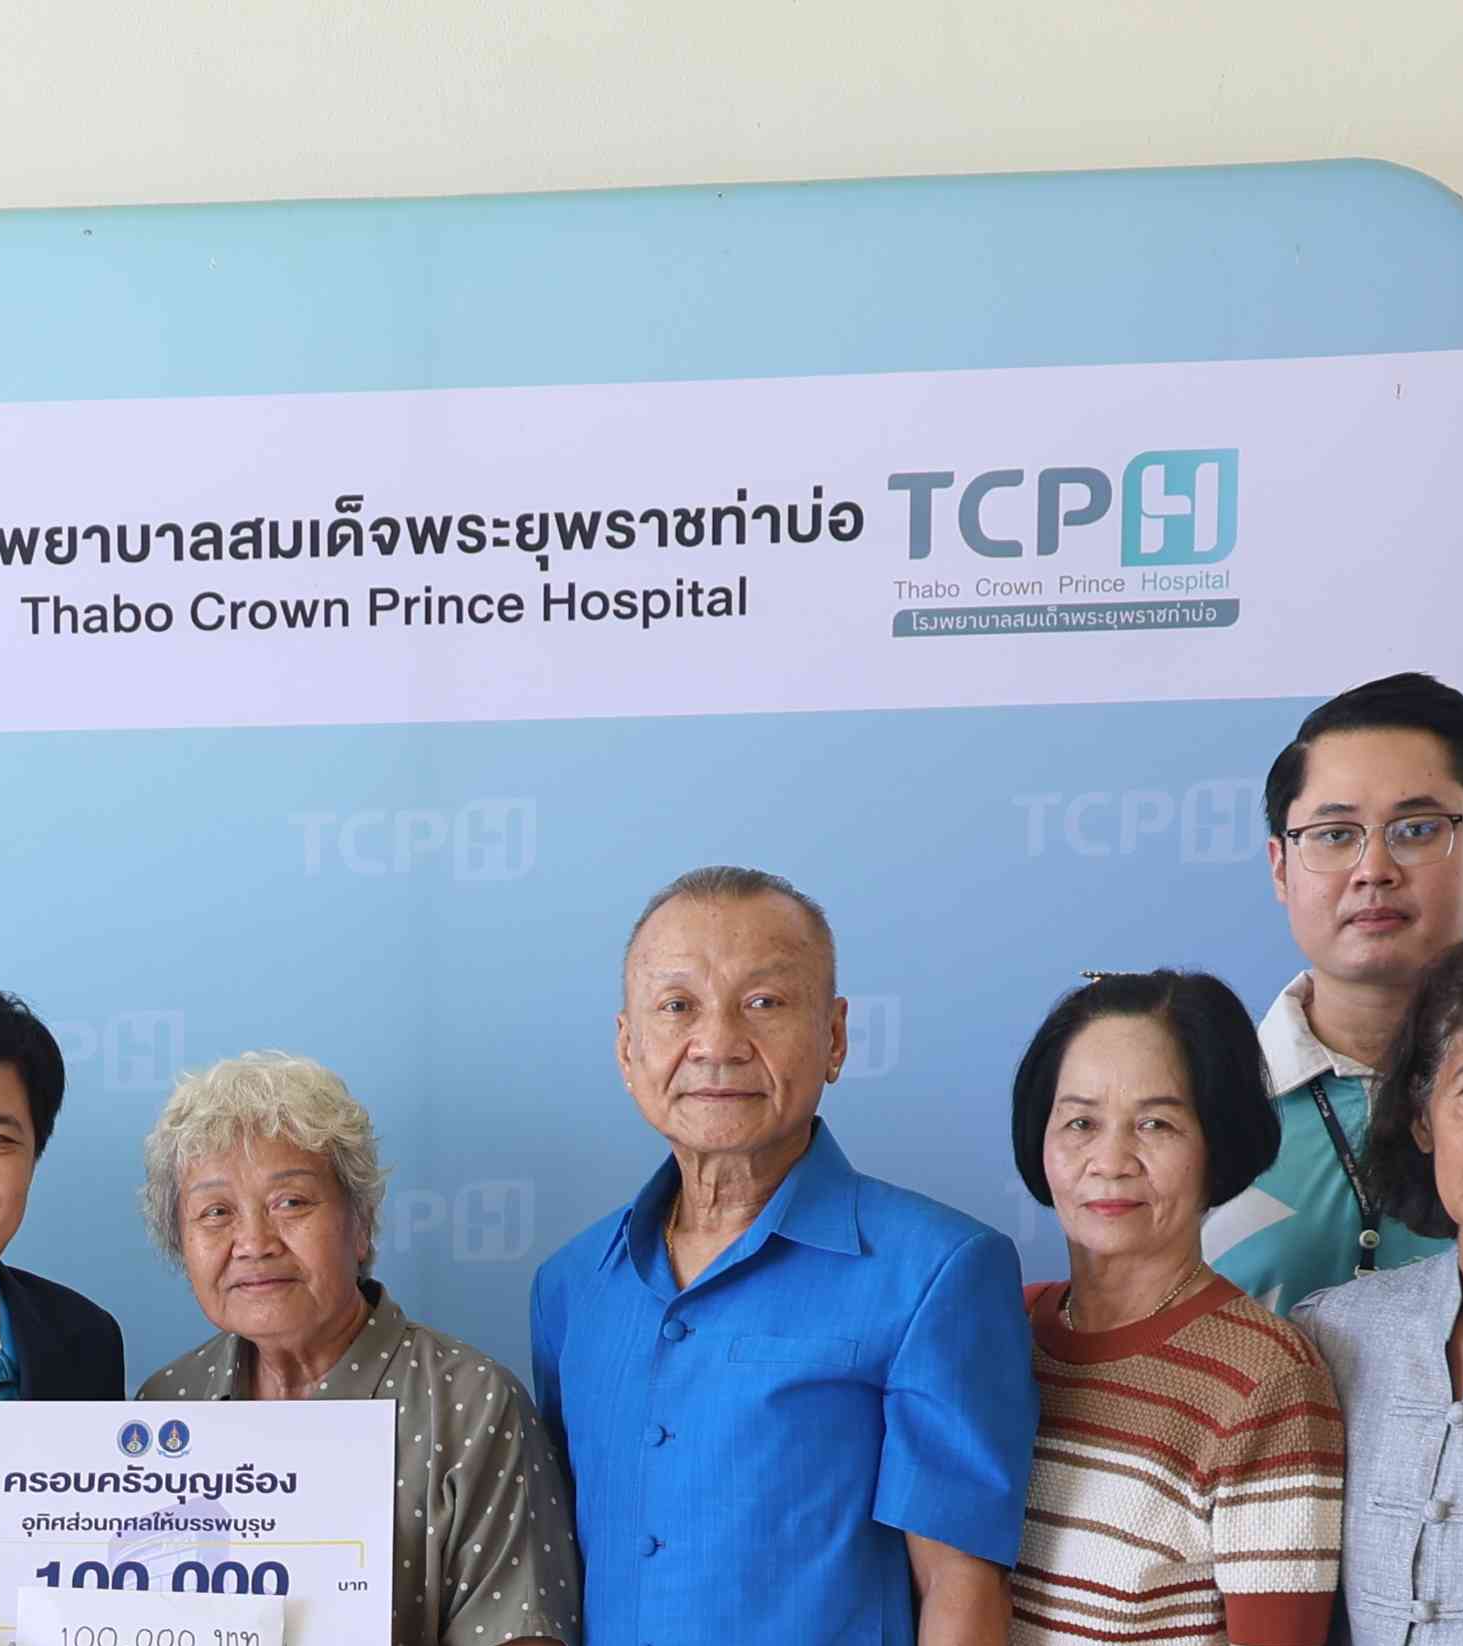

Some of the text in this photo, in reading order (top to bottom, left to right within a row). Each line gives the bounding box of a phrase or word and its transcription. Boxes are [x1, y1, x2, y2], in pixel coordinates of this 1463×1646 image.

[892, 568, 1232, 601] Thabo Crown Prince Hospital
[21, 575, 748, 636] Thabo Crown Prince Hospital
[911, 602, 1219, 634] โรงพยาบาลสมเด็จพระยุพราชท่าบ่อ
[3, 1463, 298, 1505] ครอบครัวบุญเรือง
[21, 1511, 276, 1538] อุทิศส่วนกุศลให้บรรพบุรุษ
[337, 1578, 369, 1592] บาท
